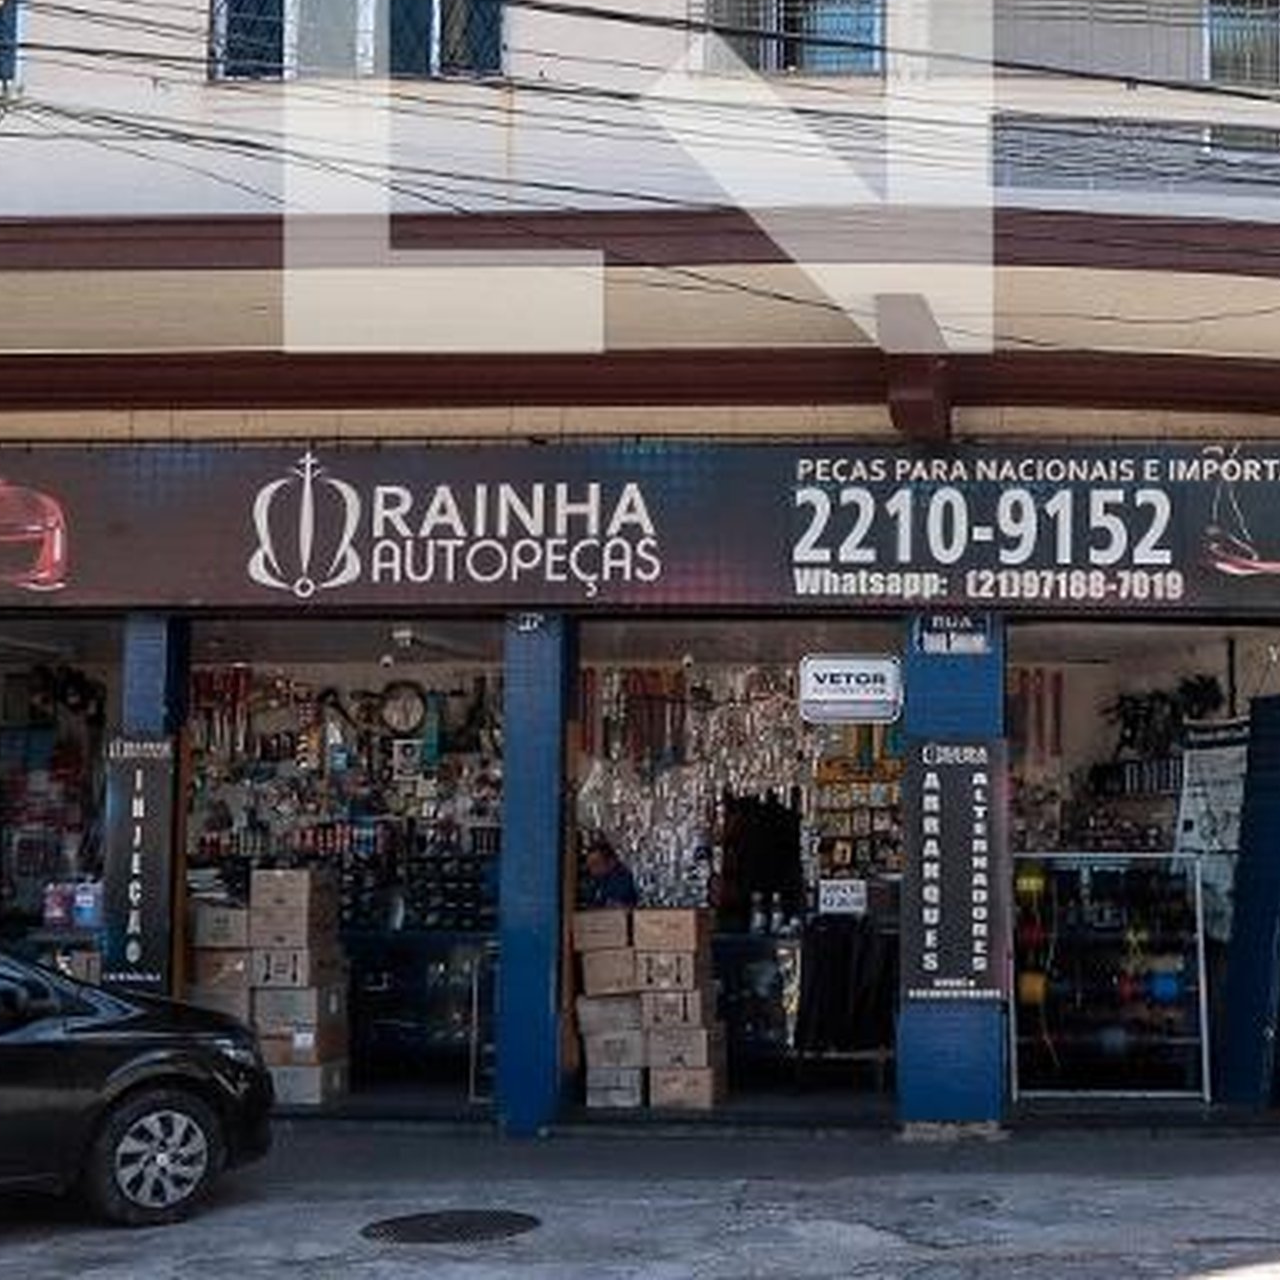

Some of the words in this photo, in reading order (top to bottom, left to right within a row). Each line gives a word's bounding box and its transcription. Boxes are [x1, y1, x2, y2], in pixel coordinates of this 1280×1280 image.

[797, 458, 887, 485] PEÇAS
[895, 459, 964, 481] PARA
[976, 459, 1135, 481] NACIONAIS
[1145, 459, 1160, 481] E
[371, 483, 657, 538] RAINHA
[793, 487, 1173, 565] 2210-9152
[371, 538, 662, 598] AUTOPEÇAS
[793, 568, 949, 600] Whatsapp:
[813, 672, 886, 685] VETOR
[923, 772, 941, 971] ARRANQUES
[972, 772, 988, 971] ALTERNADORES
